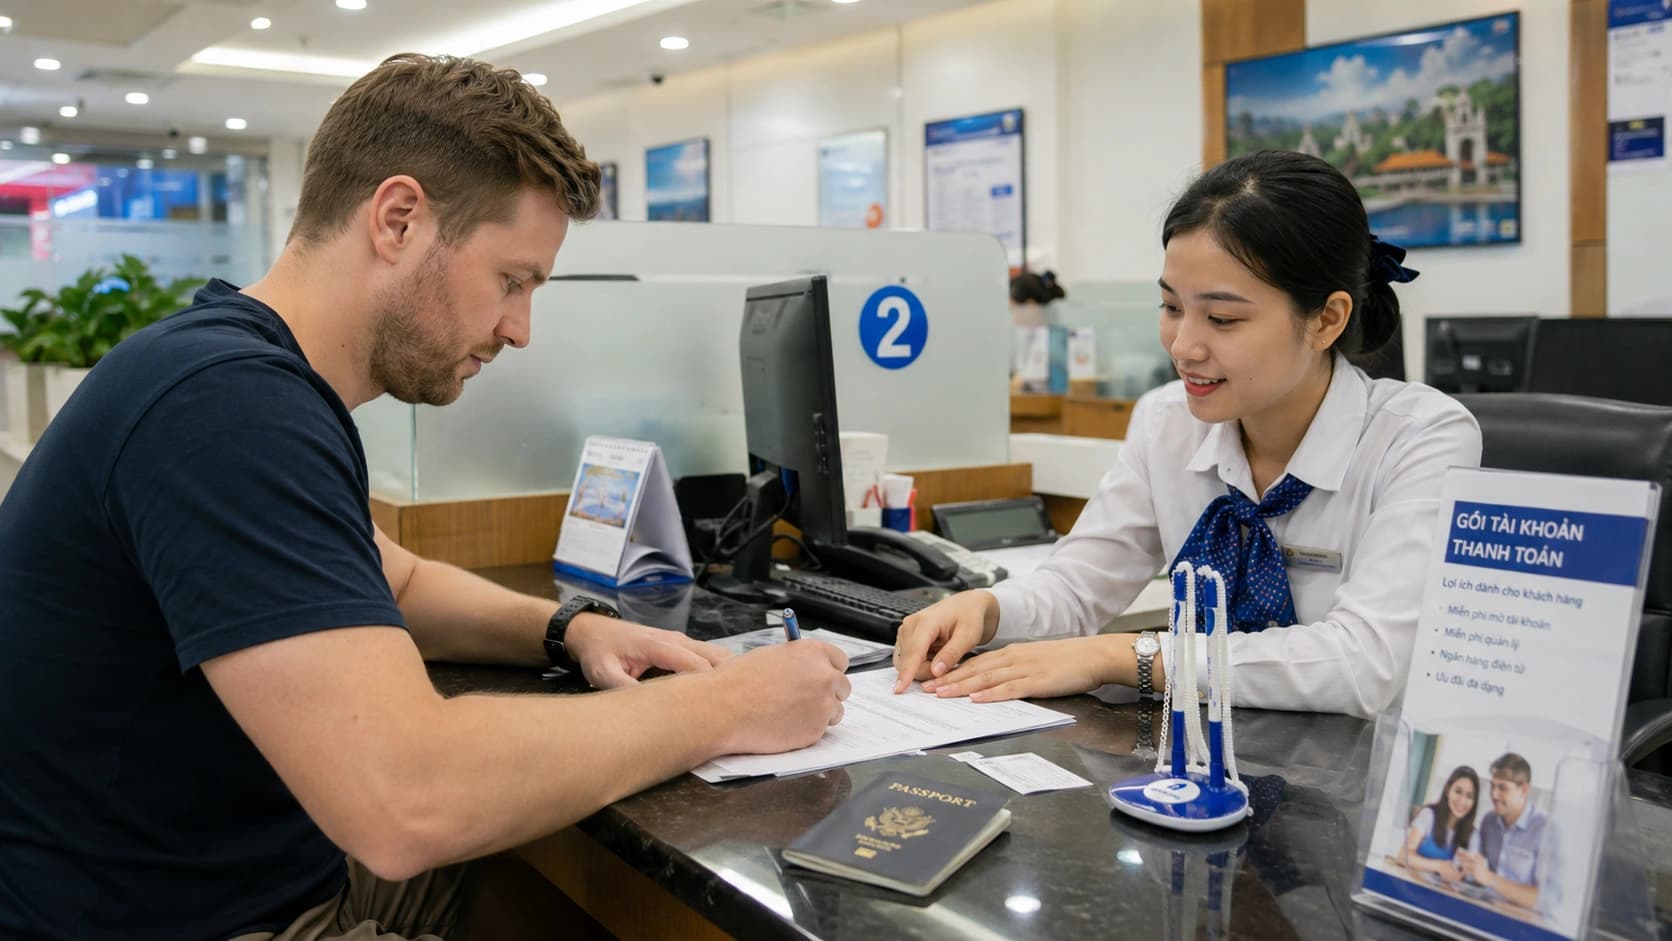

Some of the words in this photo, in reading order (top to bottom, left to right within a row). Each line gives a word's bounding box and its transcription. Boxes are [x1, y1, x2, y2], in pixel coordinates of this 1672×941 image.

[877, 296, 911, 358] 2
[1490, 513, 1516, 534] TÀI
[1453, 539, 1511, 561] THANH
[1502, 585, 1520, 598] cho
[888, 782, 976, 808] PASSPORT
